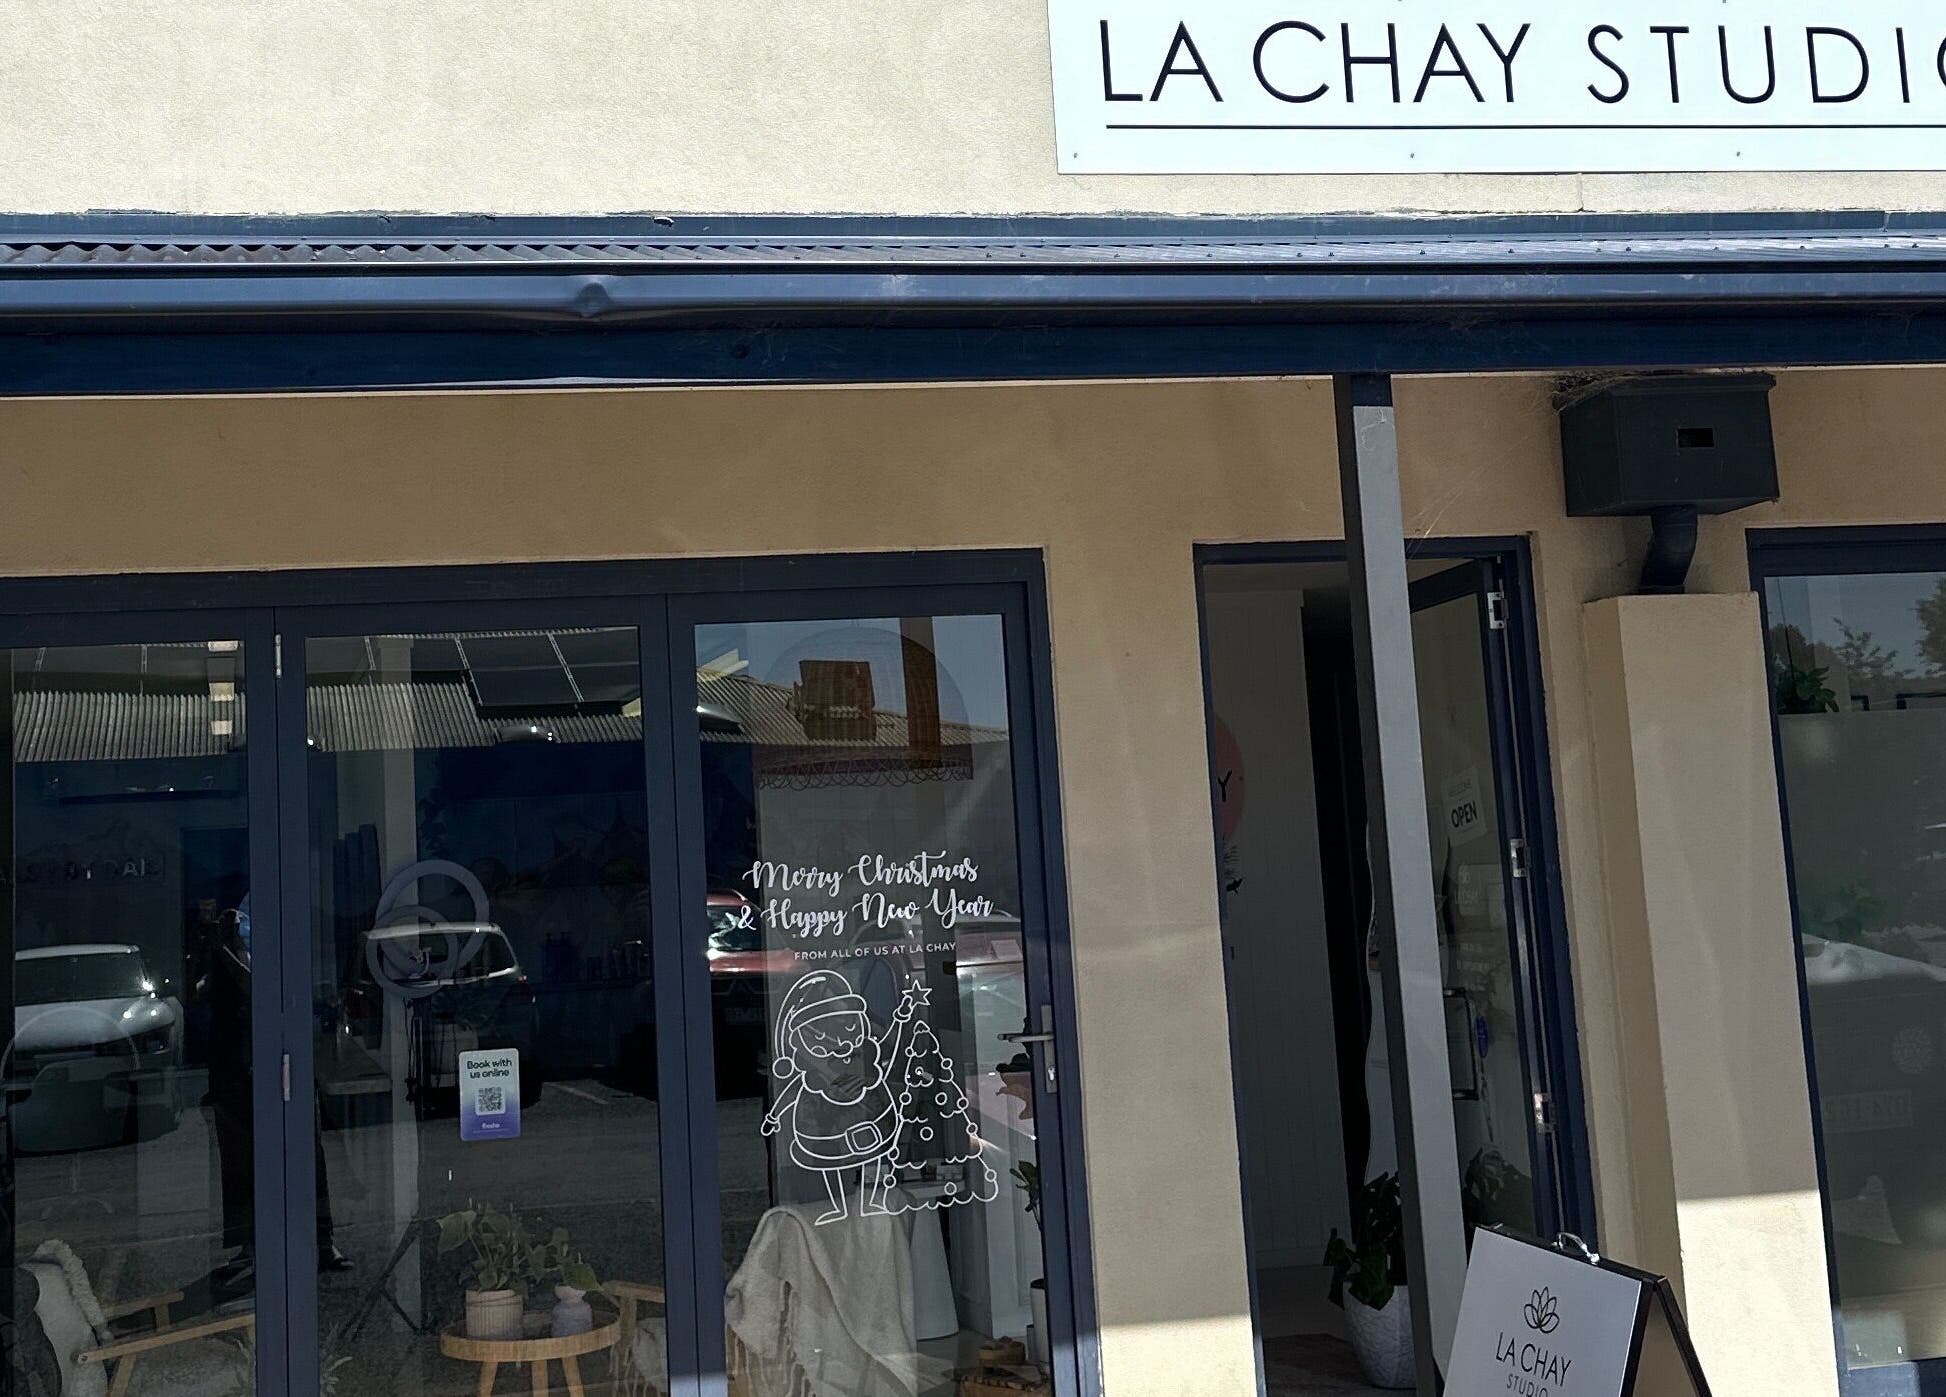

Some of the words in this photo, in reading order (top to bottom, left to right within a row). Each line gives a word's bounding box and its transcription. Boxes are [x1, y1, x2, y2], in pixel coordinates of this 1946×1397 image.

[1099, 19, 1224, 103] LA
[1252, 20, 1531, 104] CHAY
[1586, 24, 1946, 105] STUDI
[1451, 800, 1478, 828] OPEN
[742, 860, 843, 898] Merry
[848, 850, 979, 887] Christmas
[737, 905, 757, 931] &
[760, 898, 848, 938] Happy
[852, 892, 920, 929] New
[925, 888, 994, 929] Year
[794, 951, 827, 961] FROM
[830, 949, 851, 959] ALL
[854, 947, 871, 957] OF
[874, 945, 888, 955] US
[891, 945, 906, 954] AT
[909, 945, 923, 954] LA
[926, 942, 956, 952] CHAY
[467, 1060, 490, 1070] Book
[492, 1058, 512, 1067] with
[482, 1068, 510, 1078] online
[1496, 1331, 1515, 1367] LA
[1521, 1343, 1571, 1387] CHAY
[1506, 1373, 1548, 1397] STUDIO
